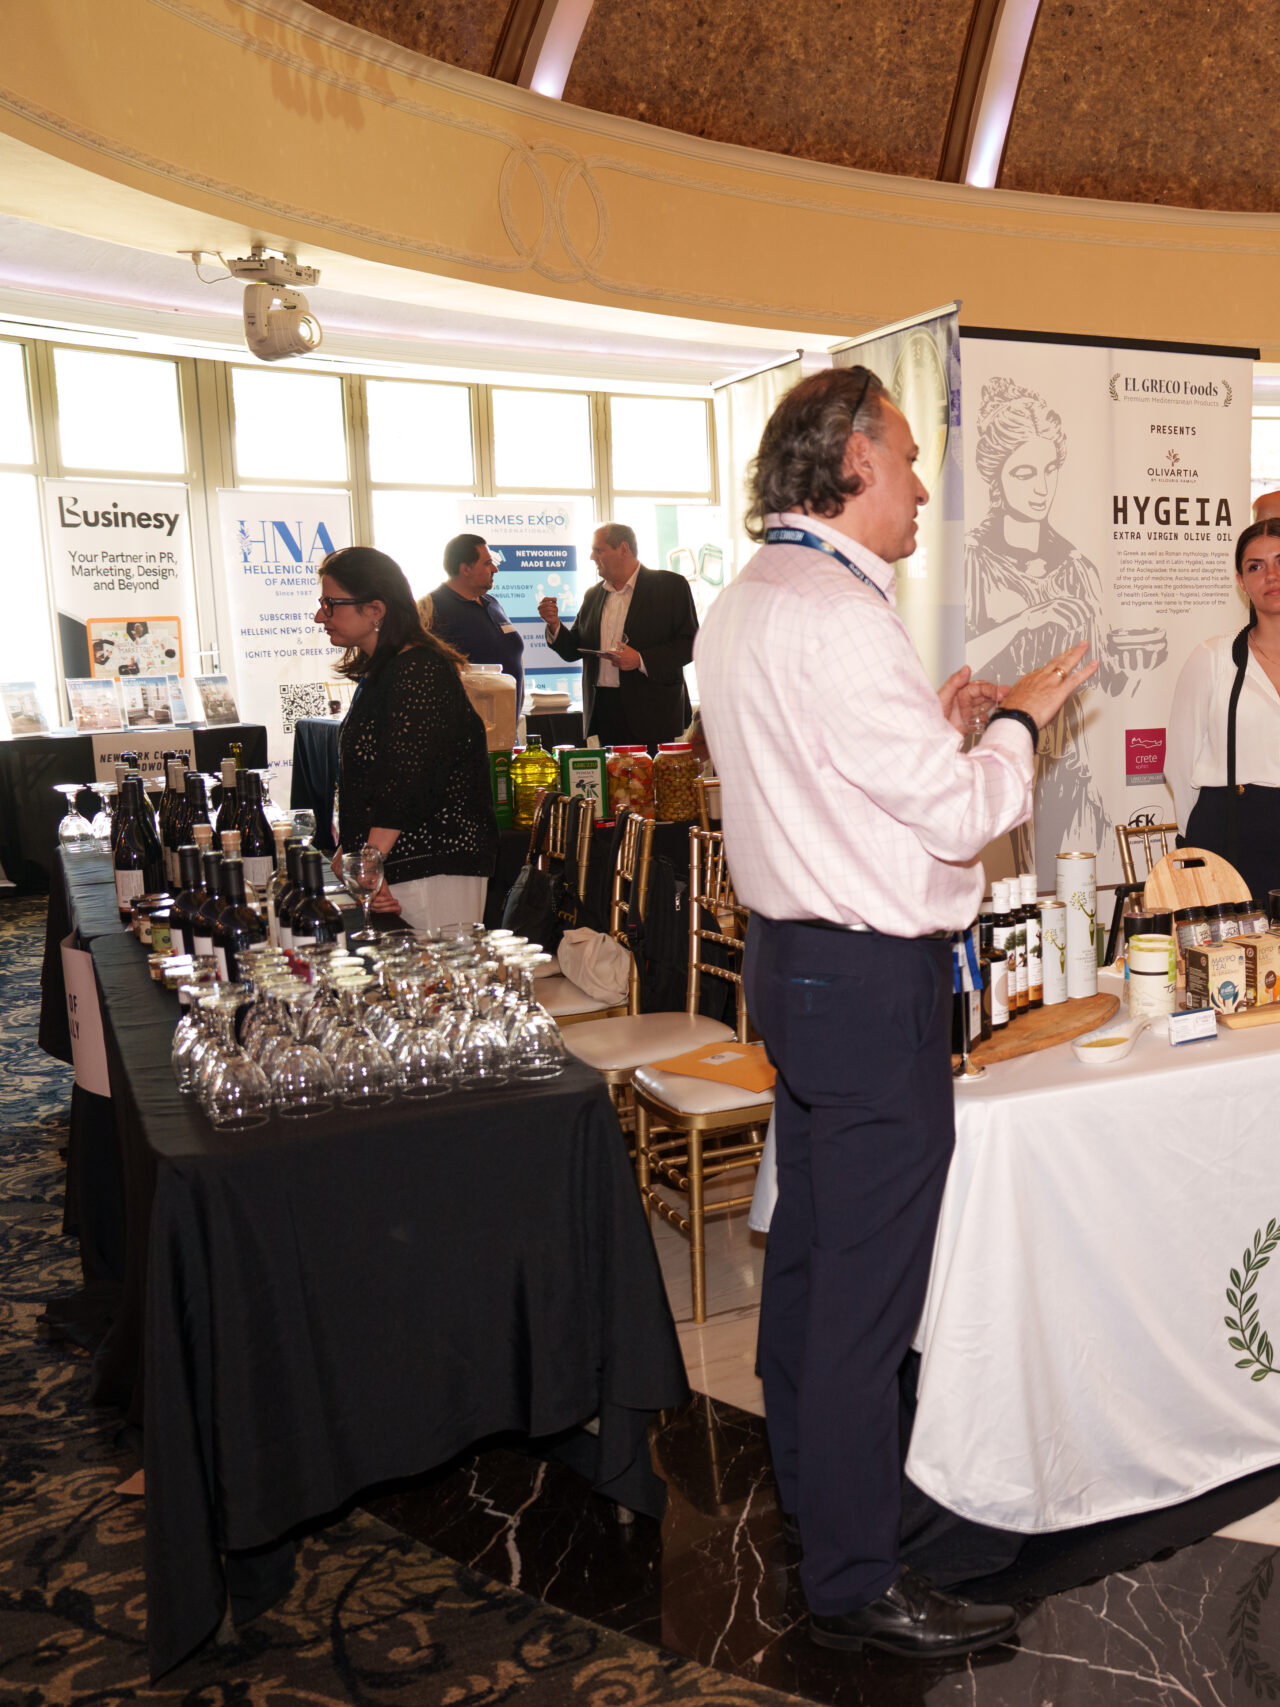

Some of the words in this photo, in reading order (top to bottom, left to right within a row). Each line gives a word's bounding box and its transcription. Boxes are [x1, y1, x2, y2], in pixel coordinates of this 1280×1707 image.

[1125, 377, 1139, 392] EL
[1142, 379, 1181, 394] GRECO
[1184, 381, 1219, 396] Foods
[1123, 395, 1152, 403] Premium
[1193, 399, 1219, 407] Products
[1150, 424, 1197, 436] PRESENTS
[1147, 467, 1199, 478] OLIVARTIA
[58, 495, 180, 537] Businesy
[1113, 495, 1232, 527] HYGEIA
[465, 514, 524, 525] HERMES
[528, 514, 565, 526] EXPO
[1113, 531, 1142, 540] EXTRA
[1147, 531, 1179, 541] VIRGIN
[1184, 532, 1211, 541] OLIVE
[1216, 533, 1232, 542] OIL
[68, 550, 99, 563] Your
[101, 551, 142, 563] Partner
[145, 552, 156, 563] in
[159, 552, 178, 565] PR,
[515, 550, 568, 558] NETWORKING
[521, 560, 544, 568] MADE
[545, 560, 567, 568] EASY
[71, 565, 135, 580] Marketing,
[137, 565, 178, 580] Design,
[244, 565, 302, 575] HELLENIC
[93, 579, 115, 591] and
[118, 579, 160, 593] Beyond
[265, 578, 277, 586] OF
[259, 612, 302, 621] SUBSCRIBE
[240, 626, 278, 636] HELLENIC
[280, 626, 303, 635] NEWS
[305, 626, 315, 634] OF
[245, 650, 272, 659] IGNITE
[274, 649, 298, 658] YOUR
[300, 648, 324, 656] GREEK
[1135, 754, 1158, 764] crete
